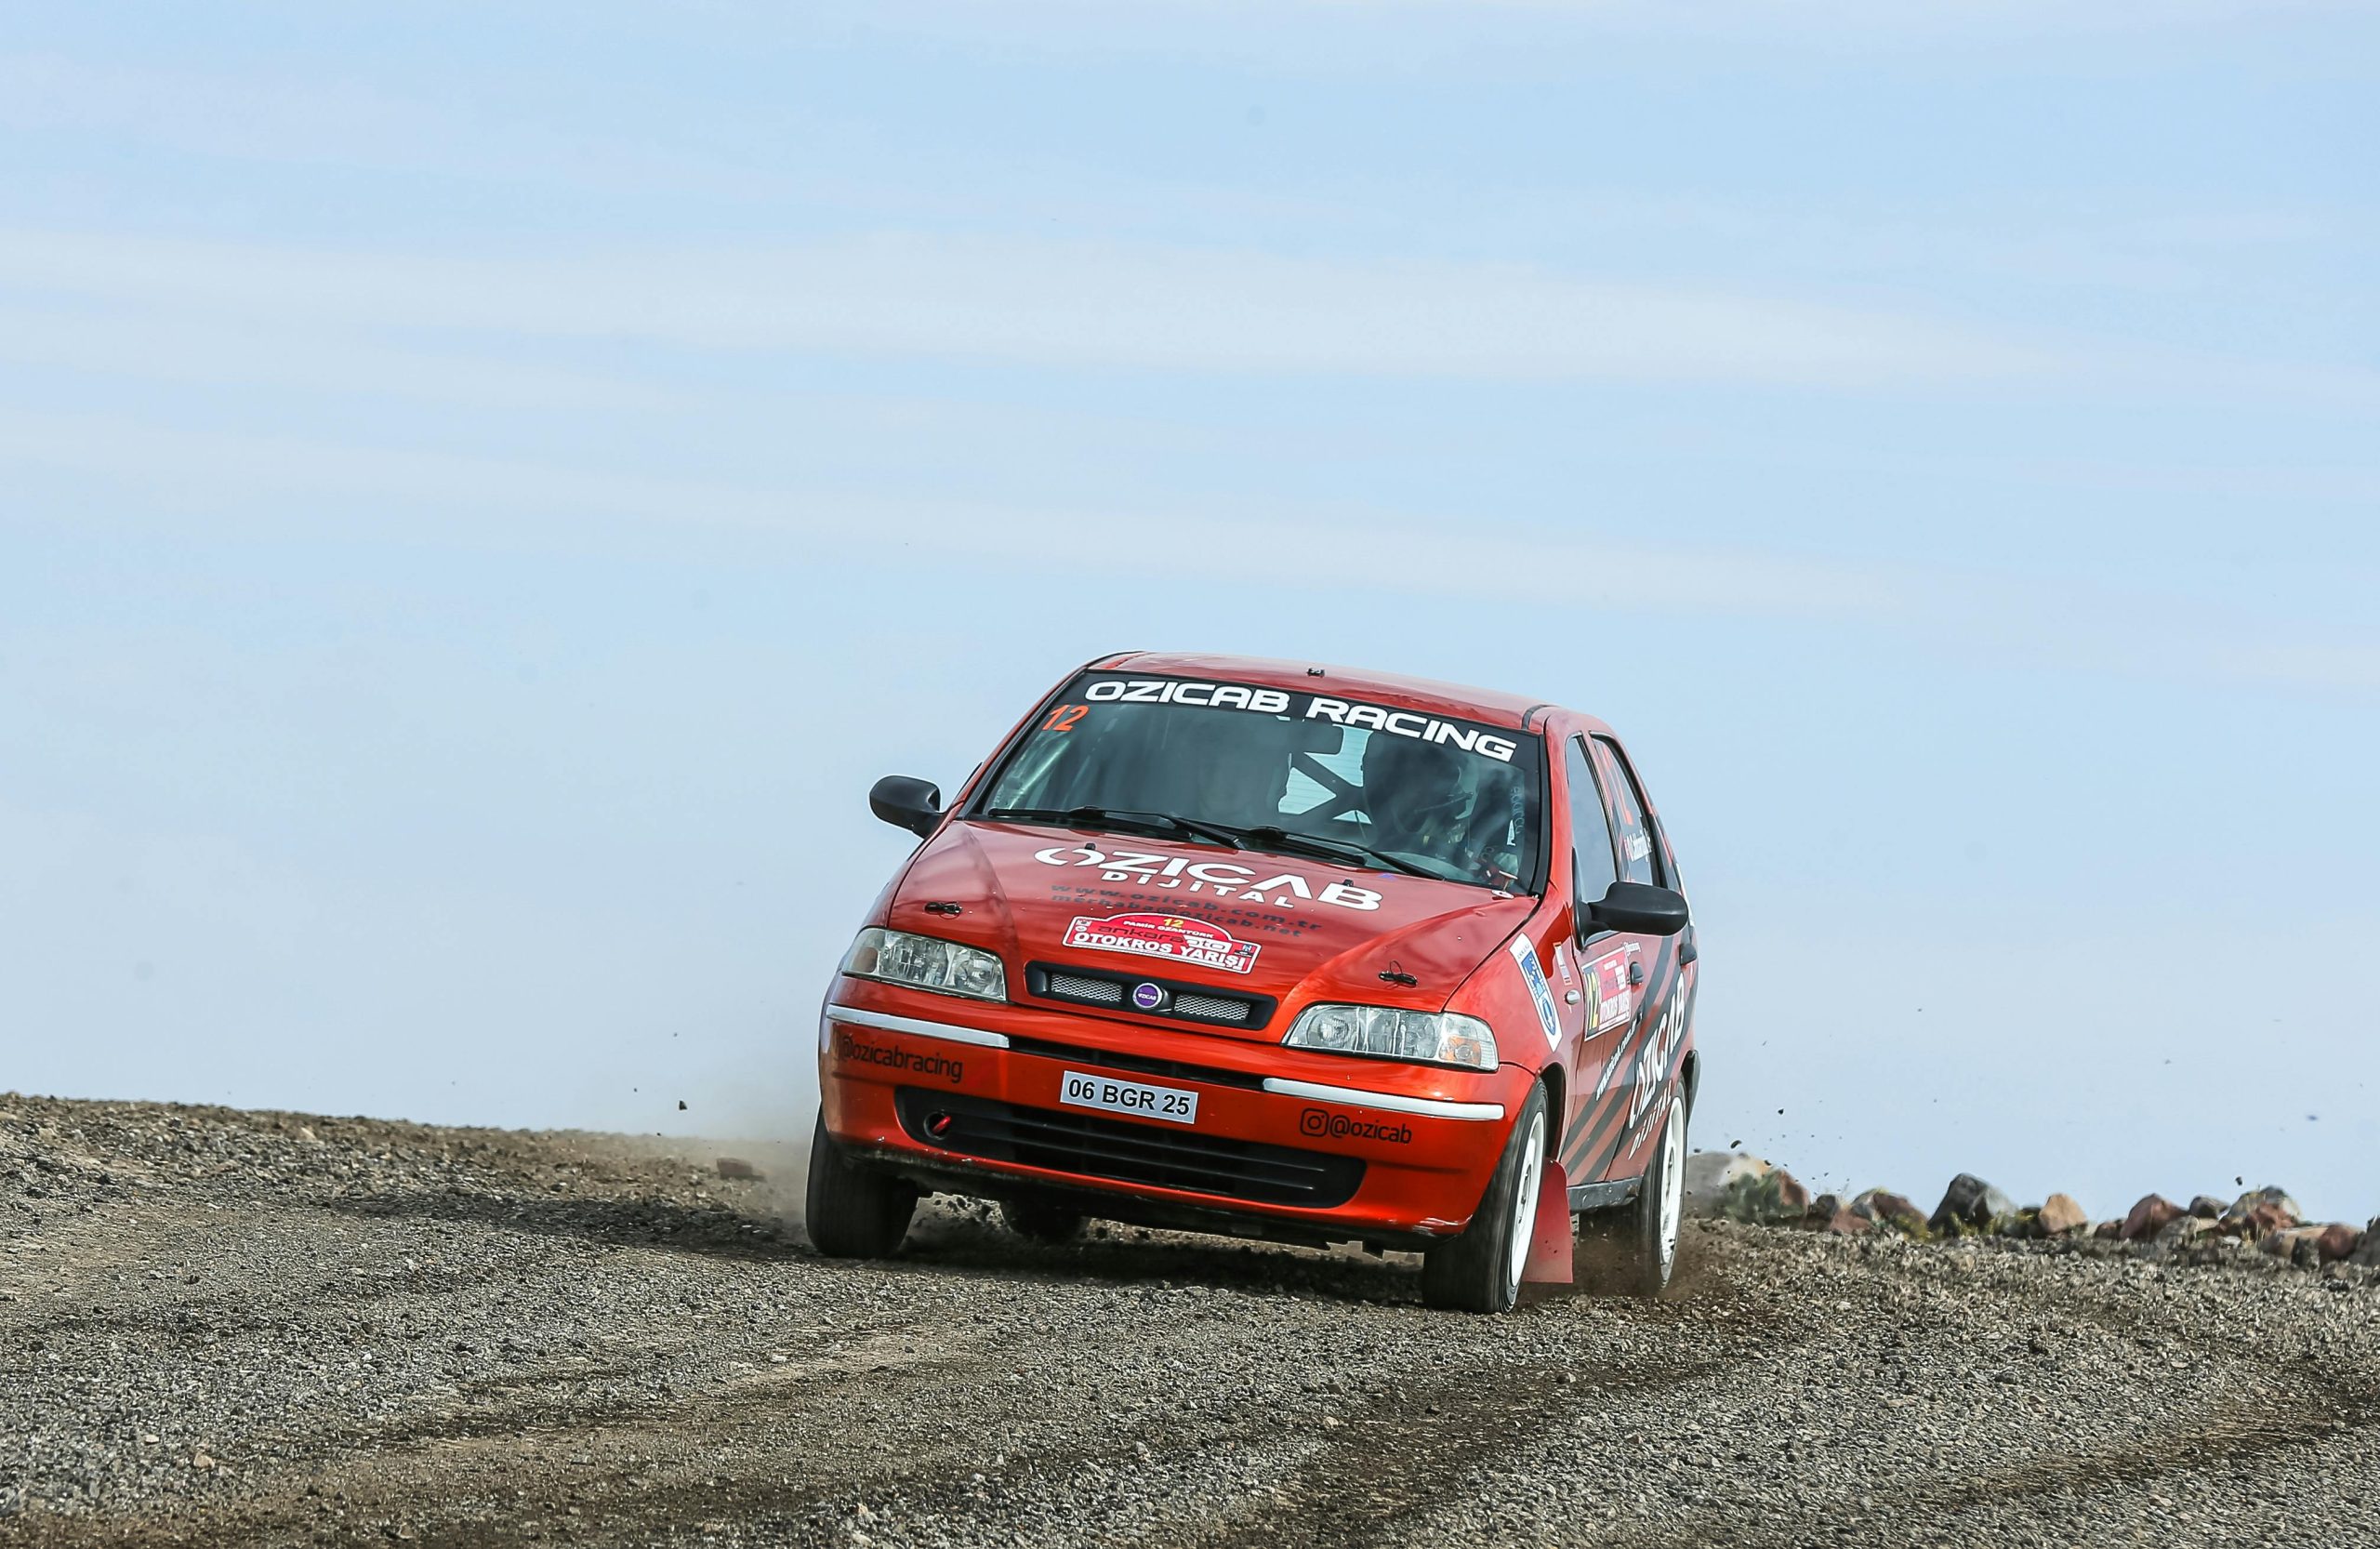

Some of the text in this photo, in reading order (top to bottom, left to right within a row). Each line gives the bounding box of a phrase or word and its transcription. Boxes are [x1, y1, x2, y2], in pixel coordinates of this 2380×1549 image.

[1042, 705, 1090, 733] 12
[1085, 681, 1517, 762] OZICAB RACING
[1034, 847, 1383, 911] OZICAB
[1051, 885, 1322, 930] www.ozicab.com.tr
[1051, 894, 1302, 936] merhaba@ozicab.net
[1163, 918, 1184, 928] 12
[1074, 932, 1173, 953] OTOKROS
[841, 1034, 964, 1084] @ozicabracing
[1629, 972, 1686, 1130] OZICAB
[1068, 1079, 1191, 1116] 06 BGR 25
[1329, 1115, 1412, 1145] @ozicab
